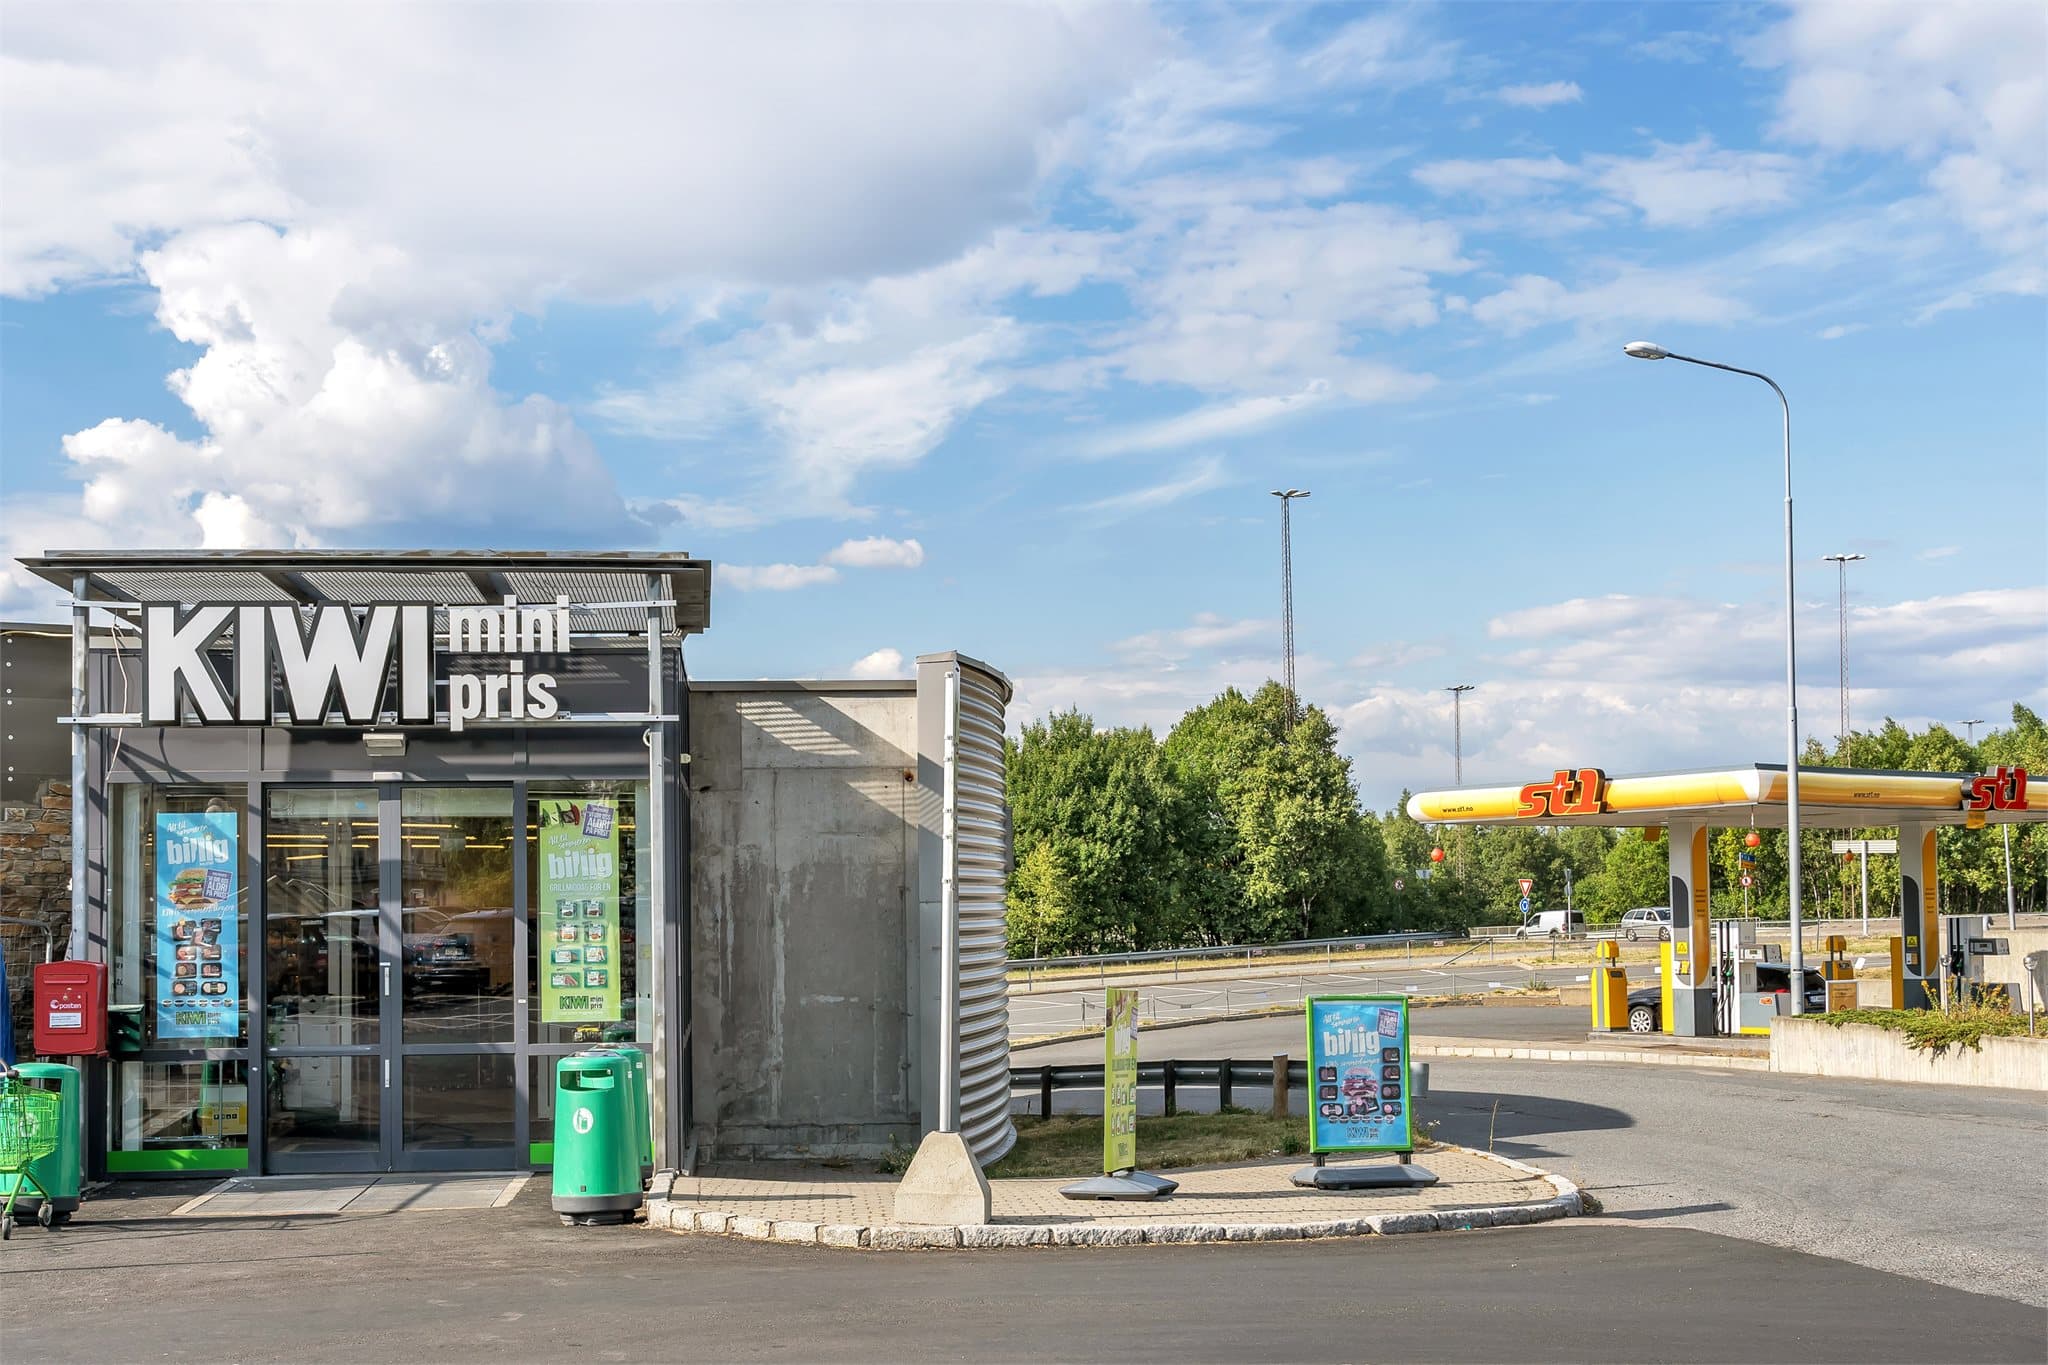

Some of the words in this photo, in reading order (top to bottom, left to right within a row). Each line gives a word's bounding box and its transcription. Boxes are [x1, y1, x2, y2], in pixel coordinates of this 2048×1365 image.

[449, 595, 570, 653] mini
[145, 602, 433, 724] KIWI
[449, 660, 559, 732] pris
[1516, 768, 1600, 817] st1
[1968, 766, 2028, 811] st1
[166, 835, 229, 864] billig
[548, 848, 613, 879] billig
[176, 1011, 206, 1025] KIWI
[560, 996, 589, 1010] KIWI
[1323, 1027, 1380, 1057] billig
